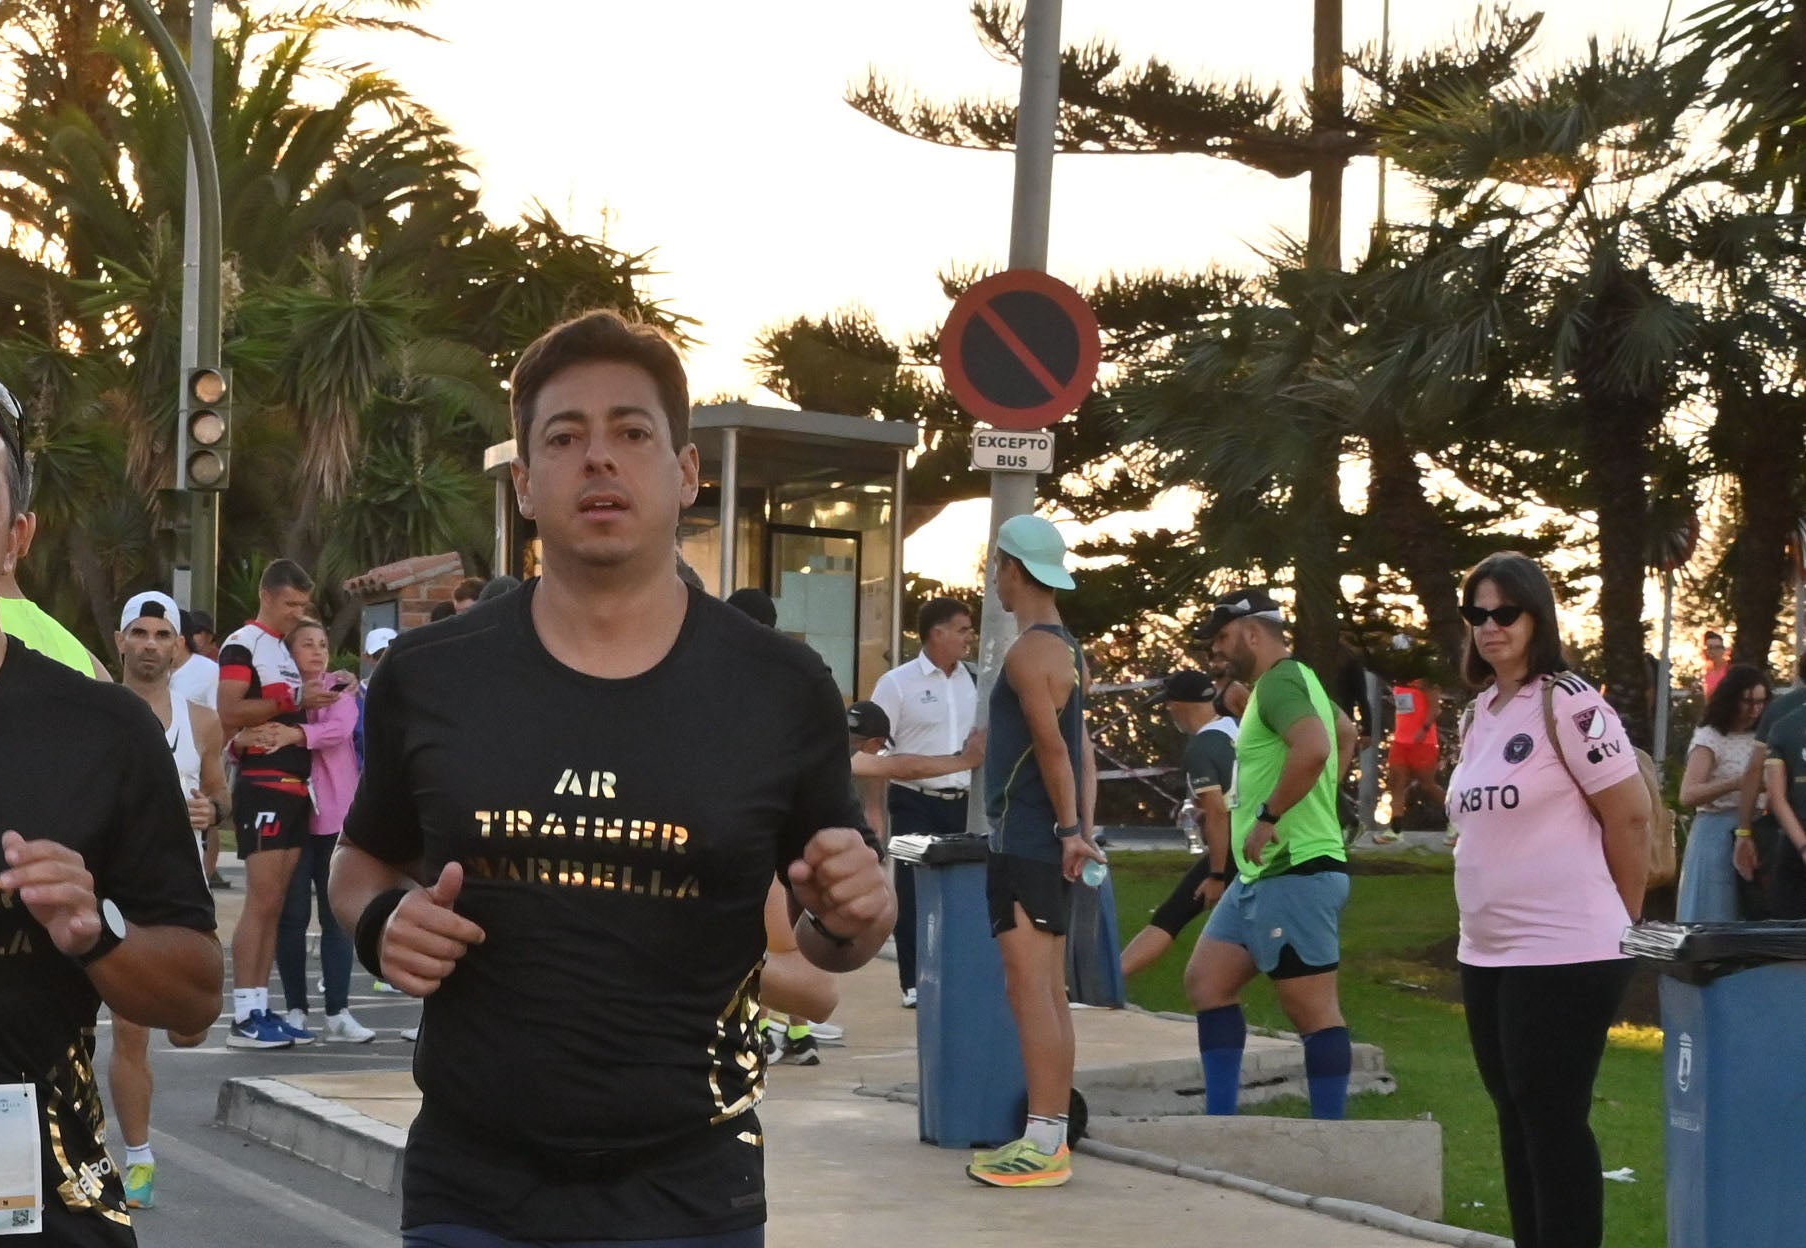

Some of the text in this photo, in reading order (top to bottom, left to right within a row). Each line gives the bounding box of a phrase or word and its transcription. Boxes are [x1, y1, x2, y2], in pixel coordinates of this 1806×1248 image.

[977, 436, 1048, 450] EXCEPTO
[996, 455, 1027, 467] BUS
[1601, 739, 1620, 757] tv
[554, 768, 617, 799] AR
[1460, 784, 1520, 813] XBTO
[475, 809, 689, 854] TRAINER
